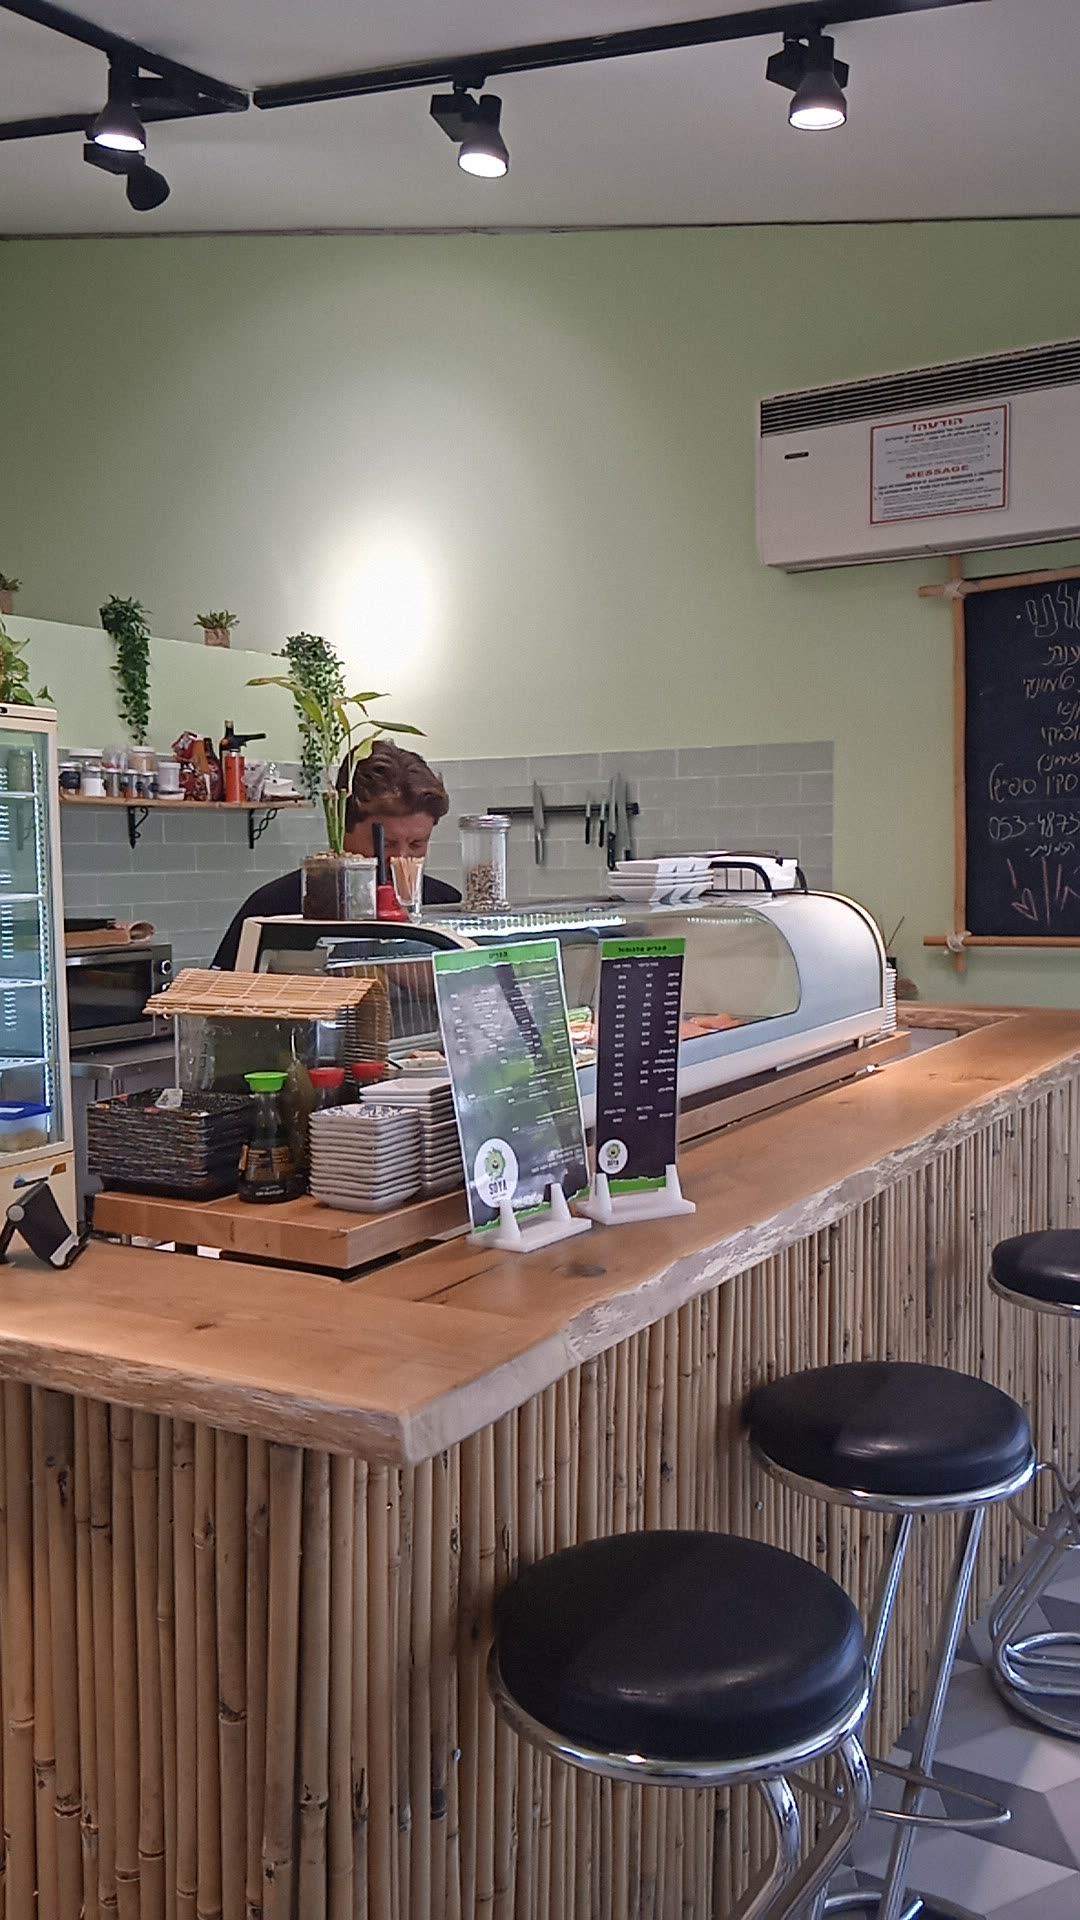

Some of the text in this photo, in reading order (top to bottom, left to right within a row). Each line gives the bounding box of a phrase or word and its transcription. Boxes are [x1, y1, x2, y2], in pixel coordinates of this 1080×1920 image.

[905, 464, 969, 479] MESSAGE
[988, 811, 1080, 841] 053-4873
[488, 1179, 508, 1195] SOYA
